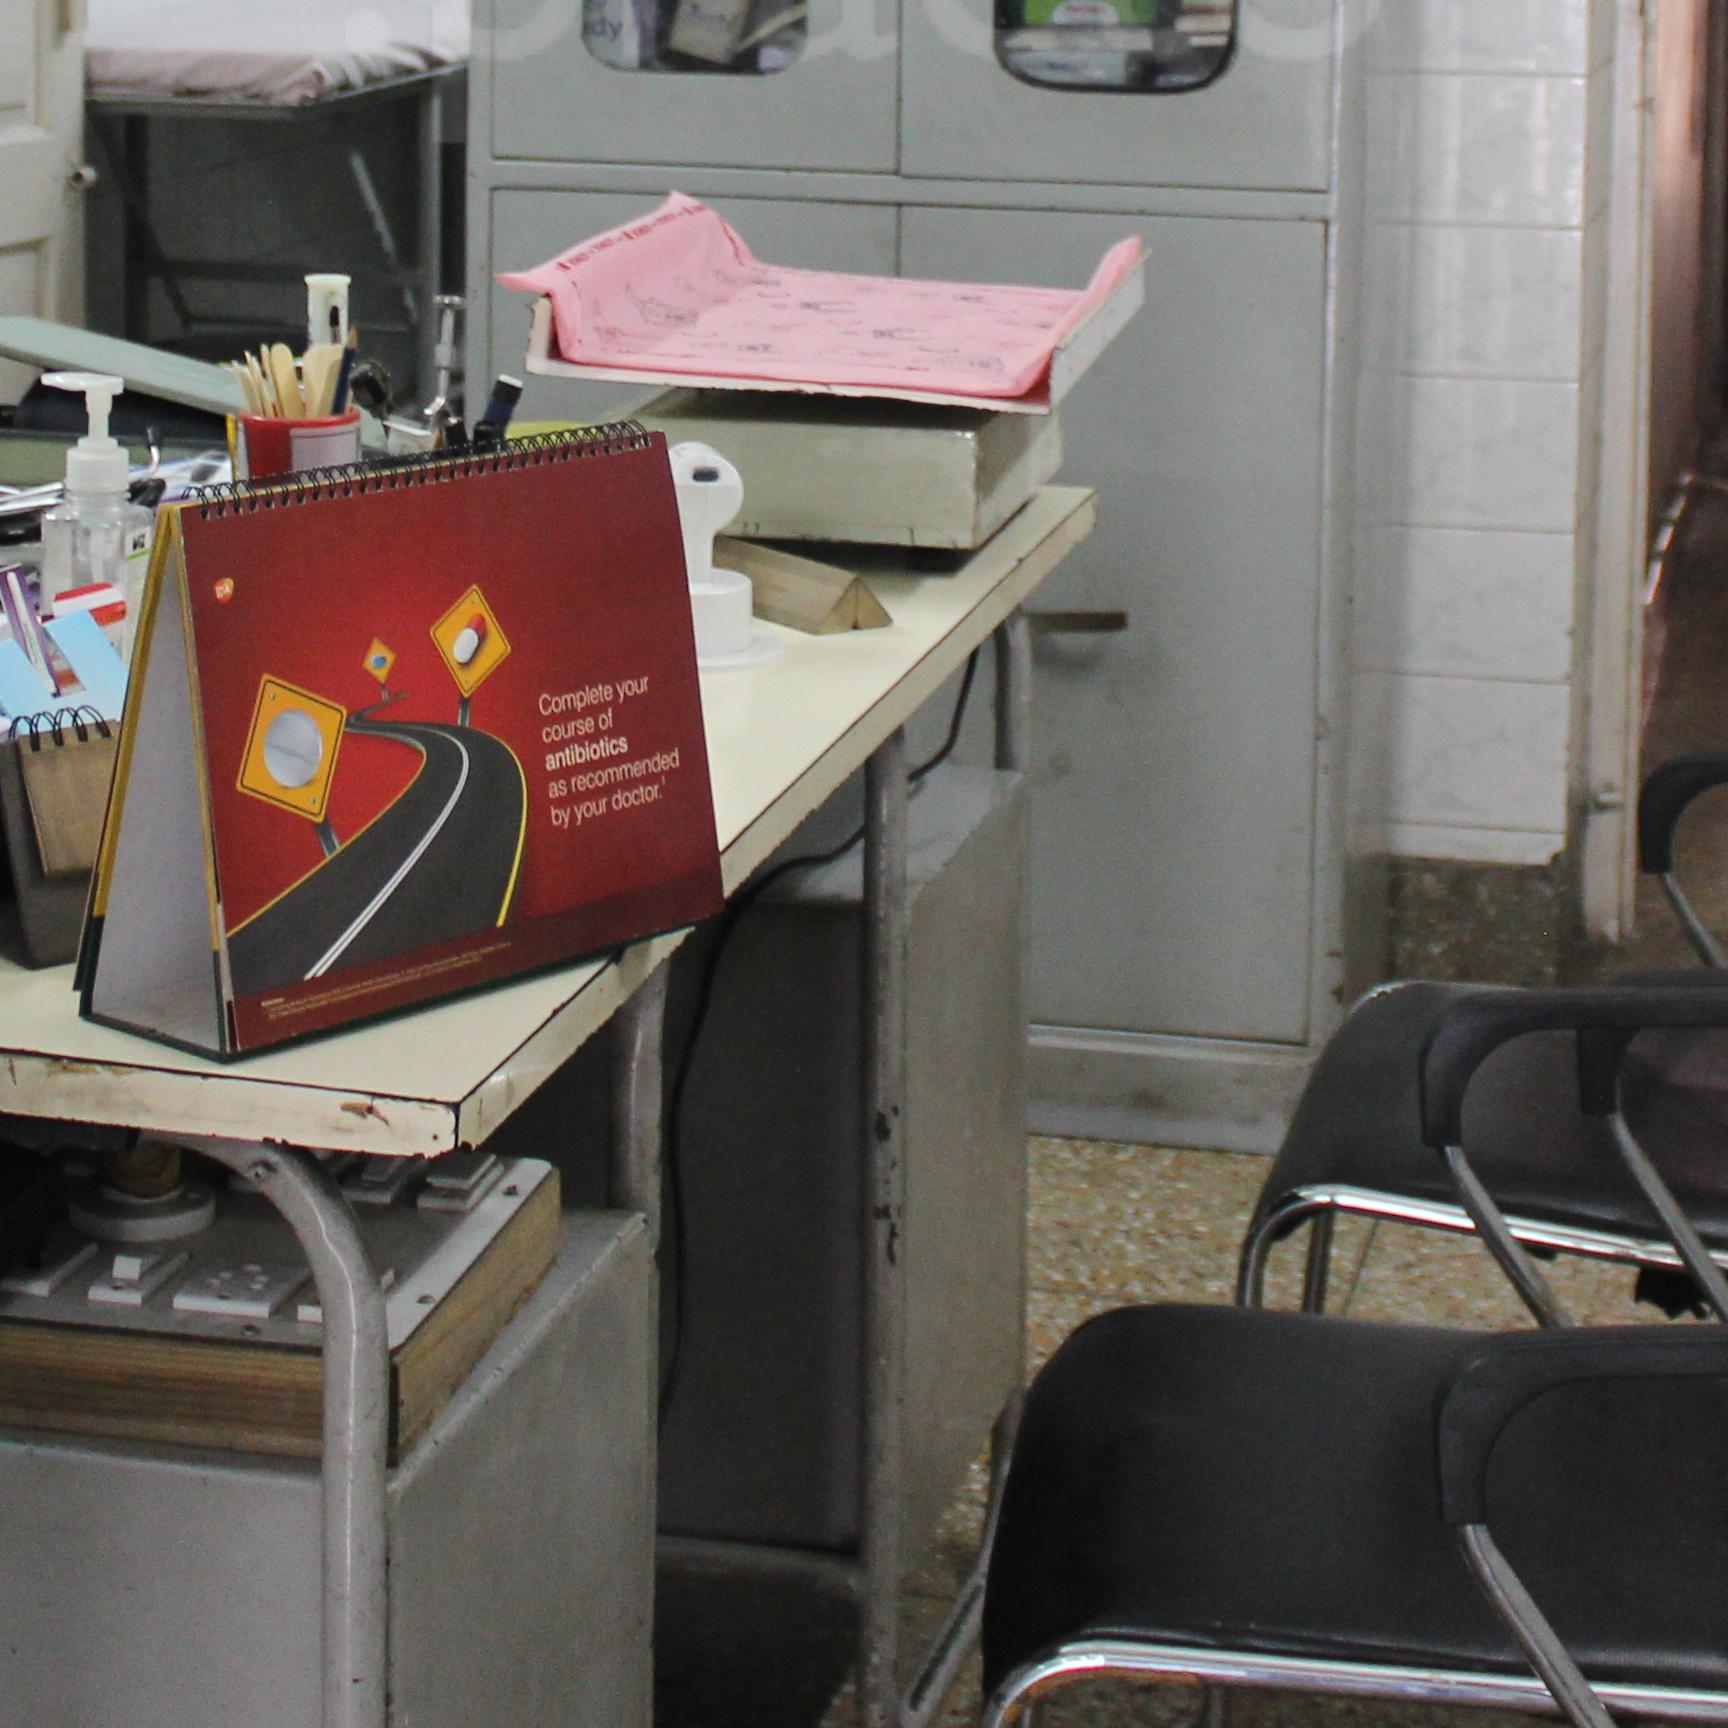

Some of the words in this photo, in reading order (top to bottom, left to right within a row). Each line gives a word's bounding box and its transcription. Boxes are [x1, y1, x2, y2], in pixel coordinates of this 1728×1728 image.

[539, 683, 613, 716] Complete
[616, 676, 649, 704] your
[542, 716, 594, 744] course
[598, 707, 614, 730] of
[545, 735, 629, 772] antibiotics
[548, 781, 567, 799] as
[571, 747, 680, 793] recommended
[550, 805, 571, 830] by
[573, 797, 608, 826] your
